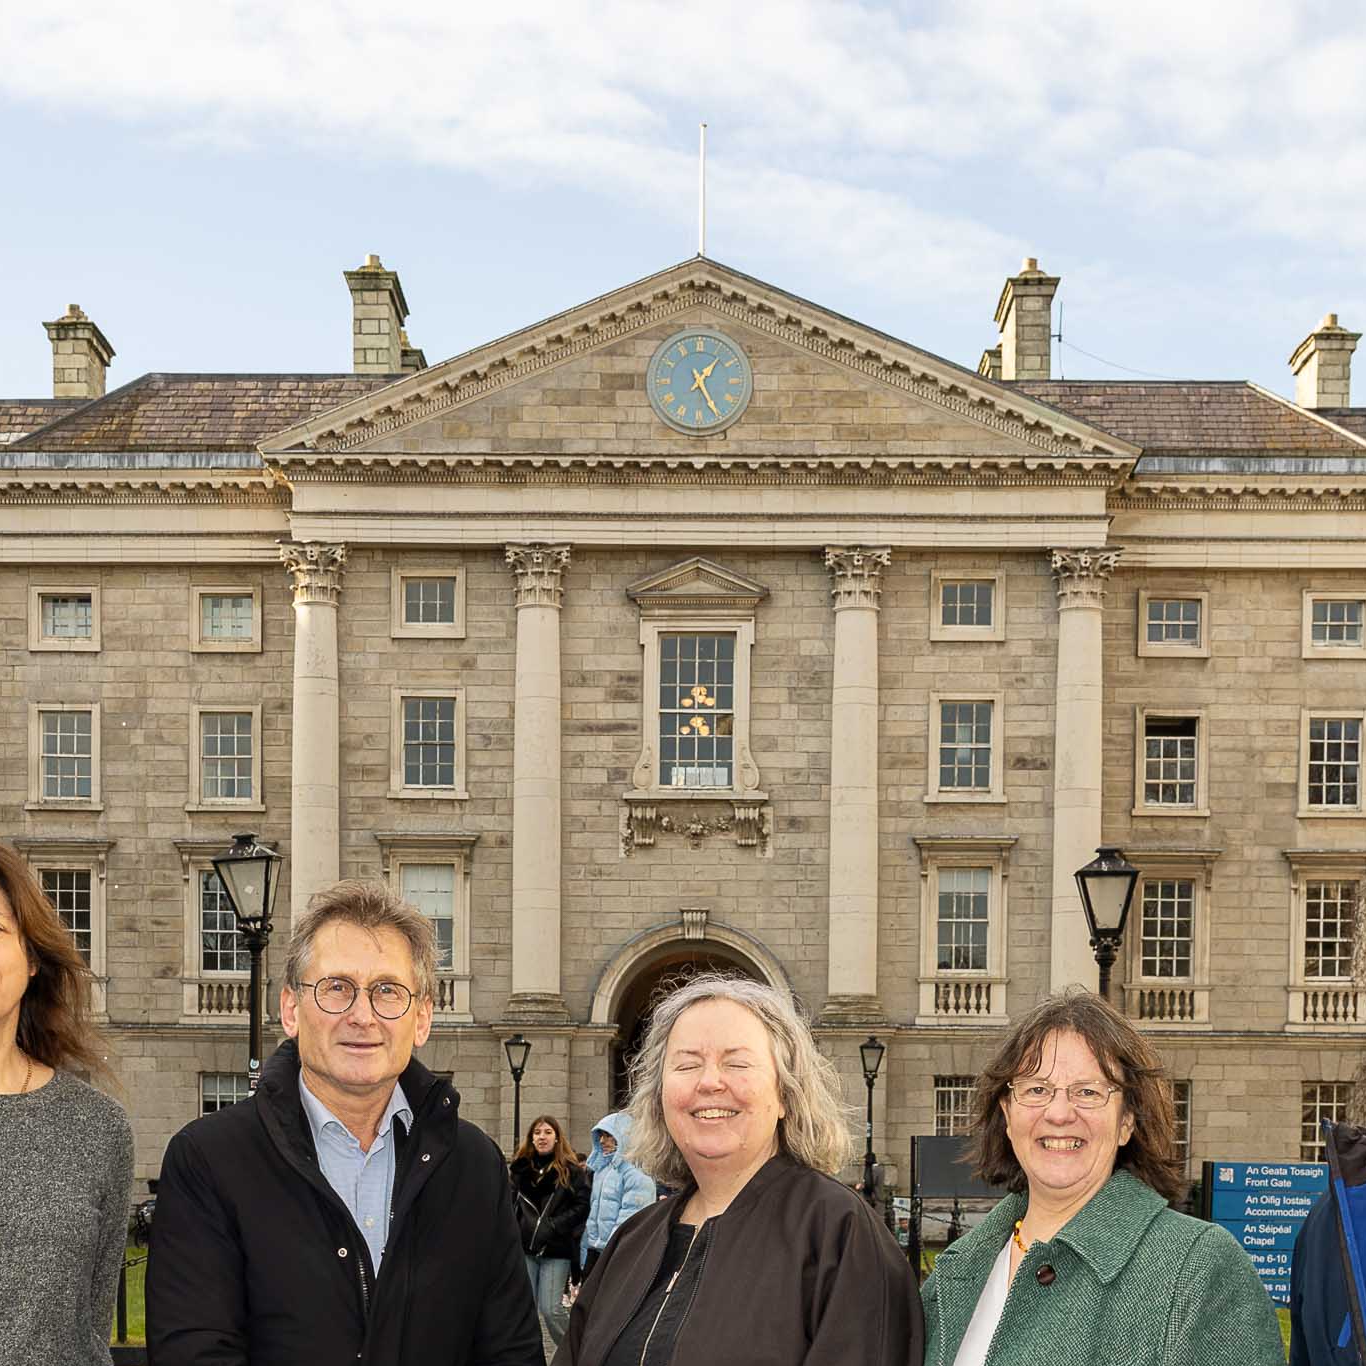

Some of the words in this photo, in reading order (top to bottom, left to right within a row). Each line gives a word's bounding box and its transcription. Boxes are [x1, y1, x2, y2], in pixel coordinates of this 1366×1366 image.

[1246, 1166, 1259, 1175] An
[1261, 1166, 1287, 1176] Geata
[1290, 1167, 1324, 1178] Tosaigh
[1245, 1178, 1268, 1187] Front
[1270, 1179, 1292, 1188] Gate
[1245, 1195, 1258, 1204] An
[1260, 1195, 1281, 1206] Oifig
[1245, 1208, 1309, 1216] Accommodatio
[1244, 1224, 1257, 1233] An
[1258, 1224, 1292, 1235] Séipéal
[1243, 1236, 1275, 1246] Chapel
[1251, 1254, 1265, 1263] the
[1267, 1254, 1288, 1264] 6-10
[1257, 1267, 1276, 1276] uses
[1277, 1267, 1291, 1276] 6-1
